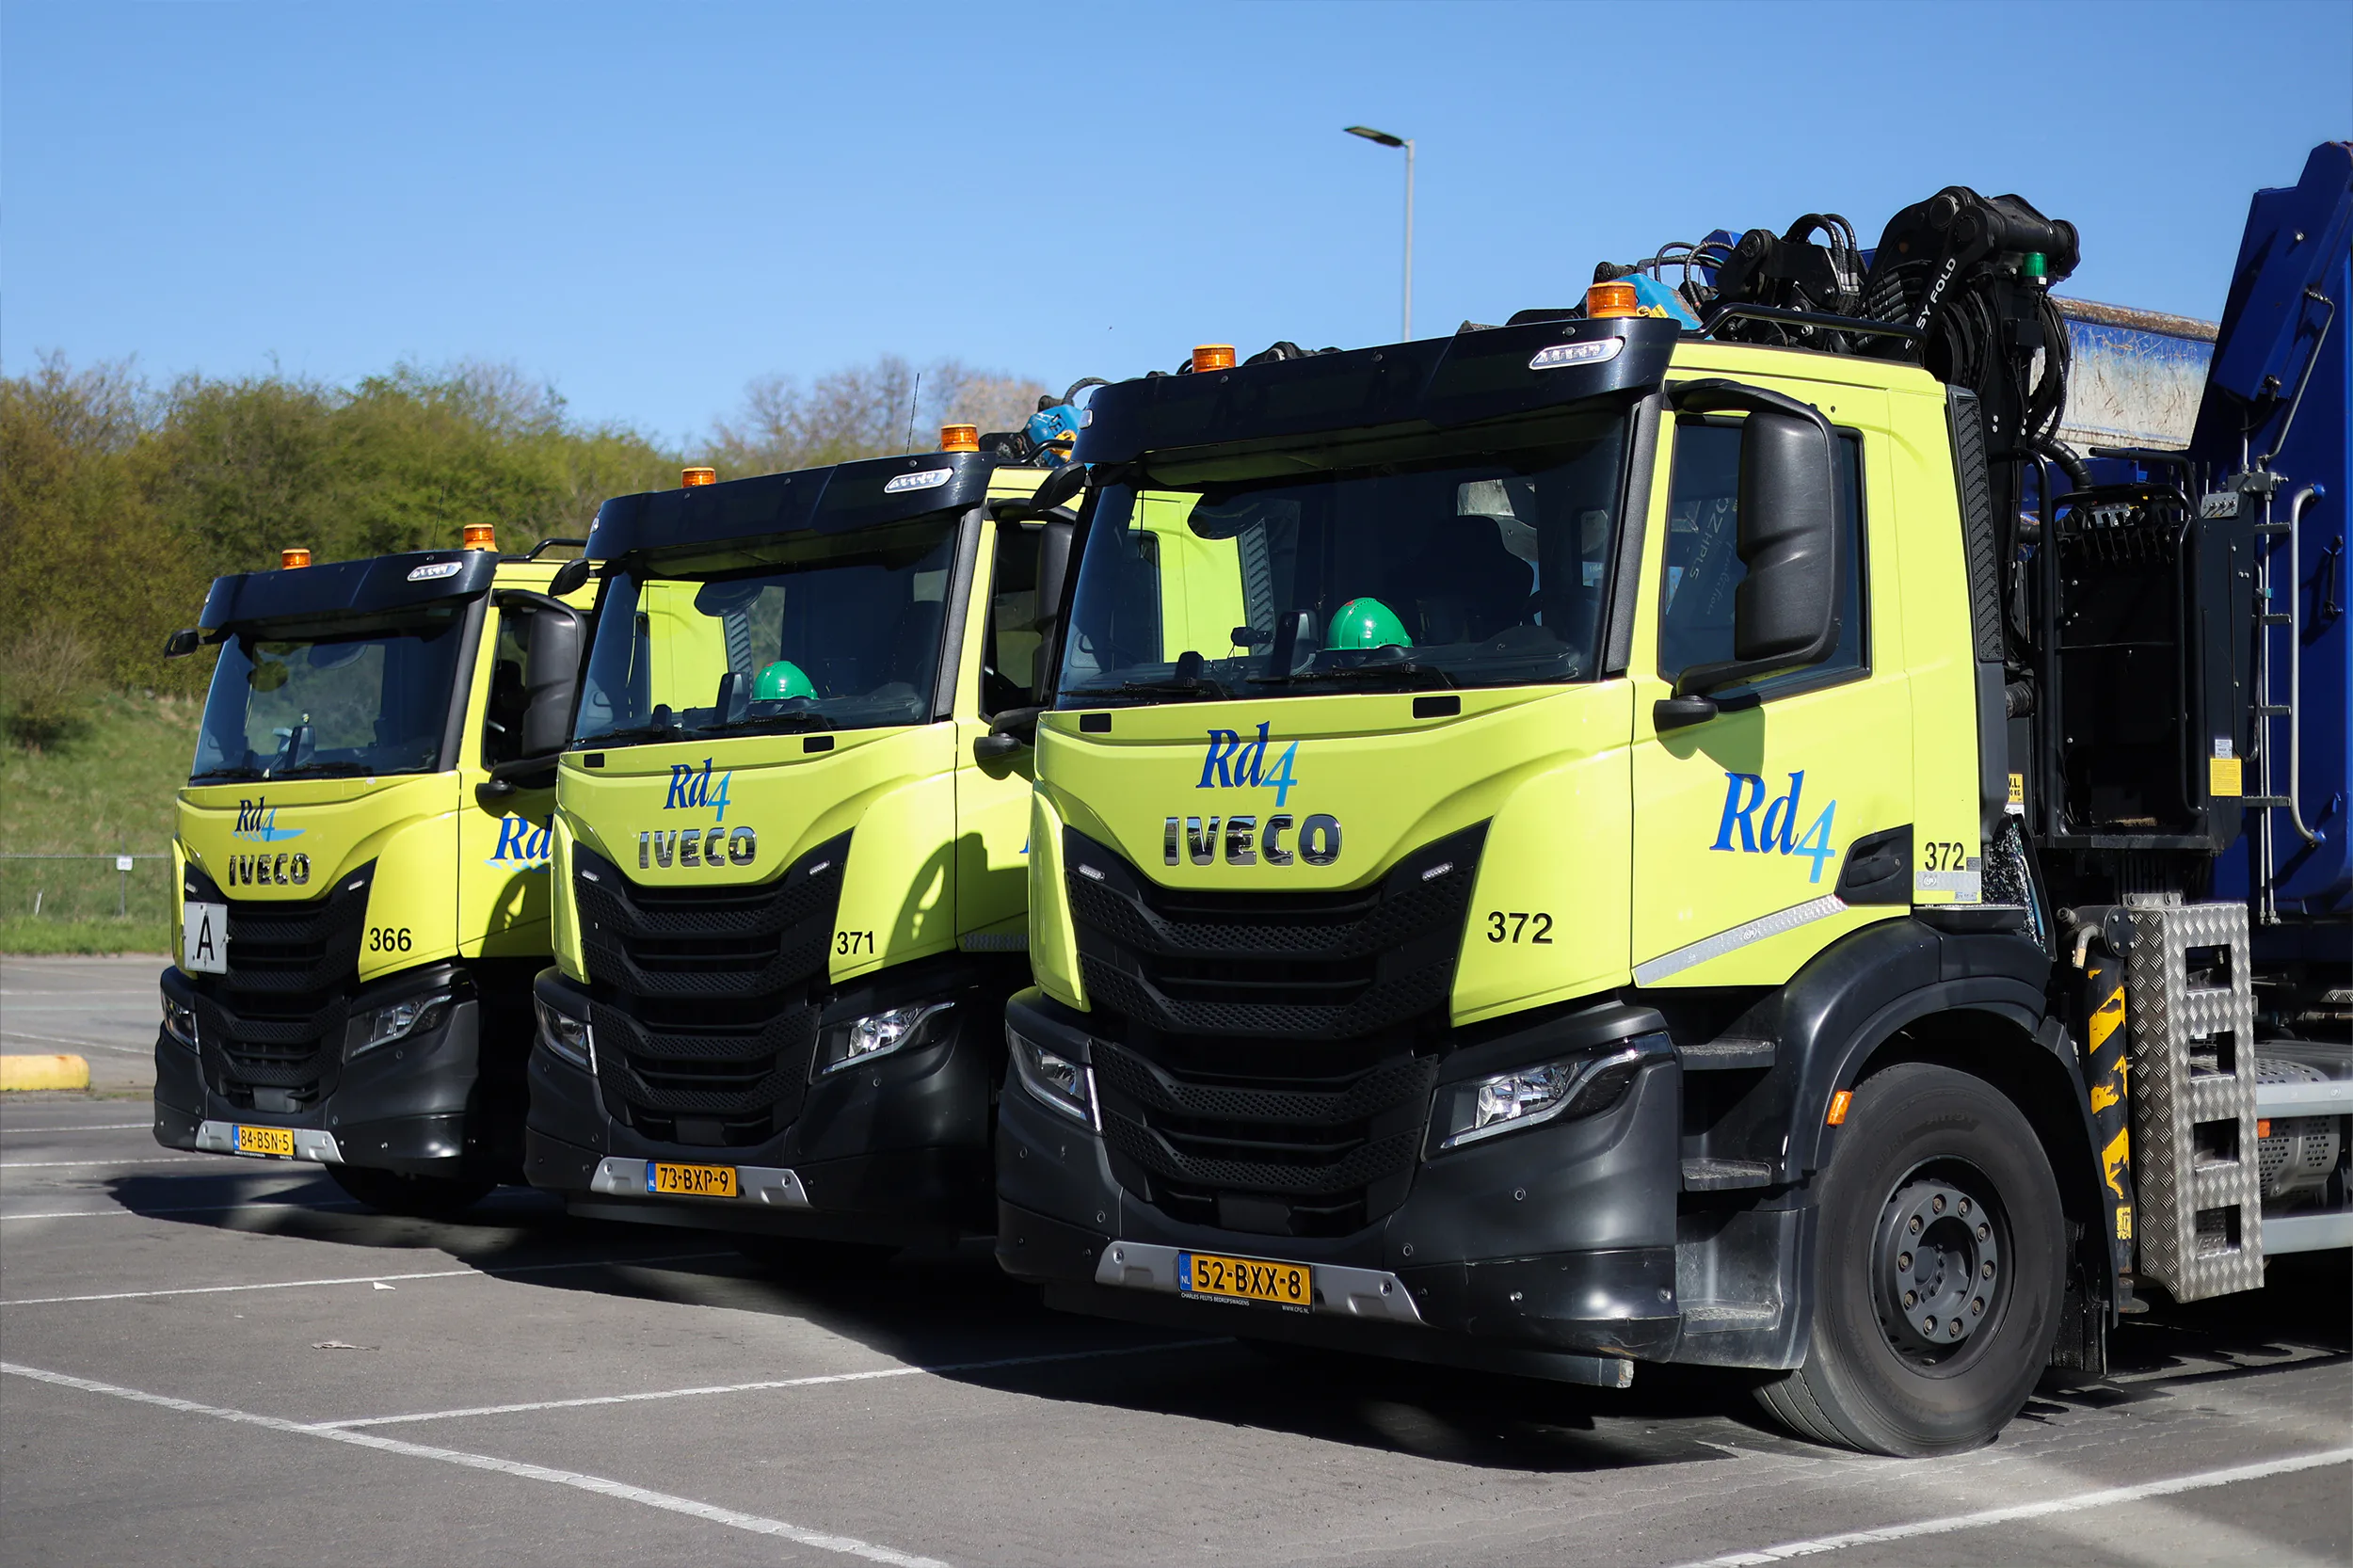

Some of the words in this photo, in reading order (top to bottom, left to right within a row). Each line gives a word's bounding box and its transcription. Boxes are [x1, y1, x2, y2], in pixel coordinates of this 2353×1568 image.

[1929, 258, 1957, 304] FOLD
[1195, 720, 1299, 808] Rd4
[664, 757, 730, 822] Rd4
[234, 796, 278, 842] Rd4
[490, 813, 553, 860] Rd
[1710, 769, 1838, 884] Rd4
[638, 825, 758, 869] IVECO
[1162, 814, 1343, 867] IVECO
[1925, 841, 1964, 872] 372
[229, 853, 312, 887] IVECO
[196, 914, 215, 961] A
[369, 927, 412, 952] 366
[836, 931, 875, 955] 371
[1487, 911, 1554, 945] 372
[241, 1128, 290, 1151] 84-BSN-5
[661, 1167, 728, 1192] 73-BXP-9
[1181, 1275, 1191, 1285] NL
[1181, 1292, 1199, 1301] CHARLES
[1197, 1259, 1303, 1300] 52-BXX-8
